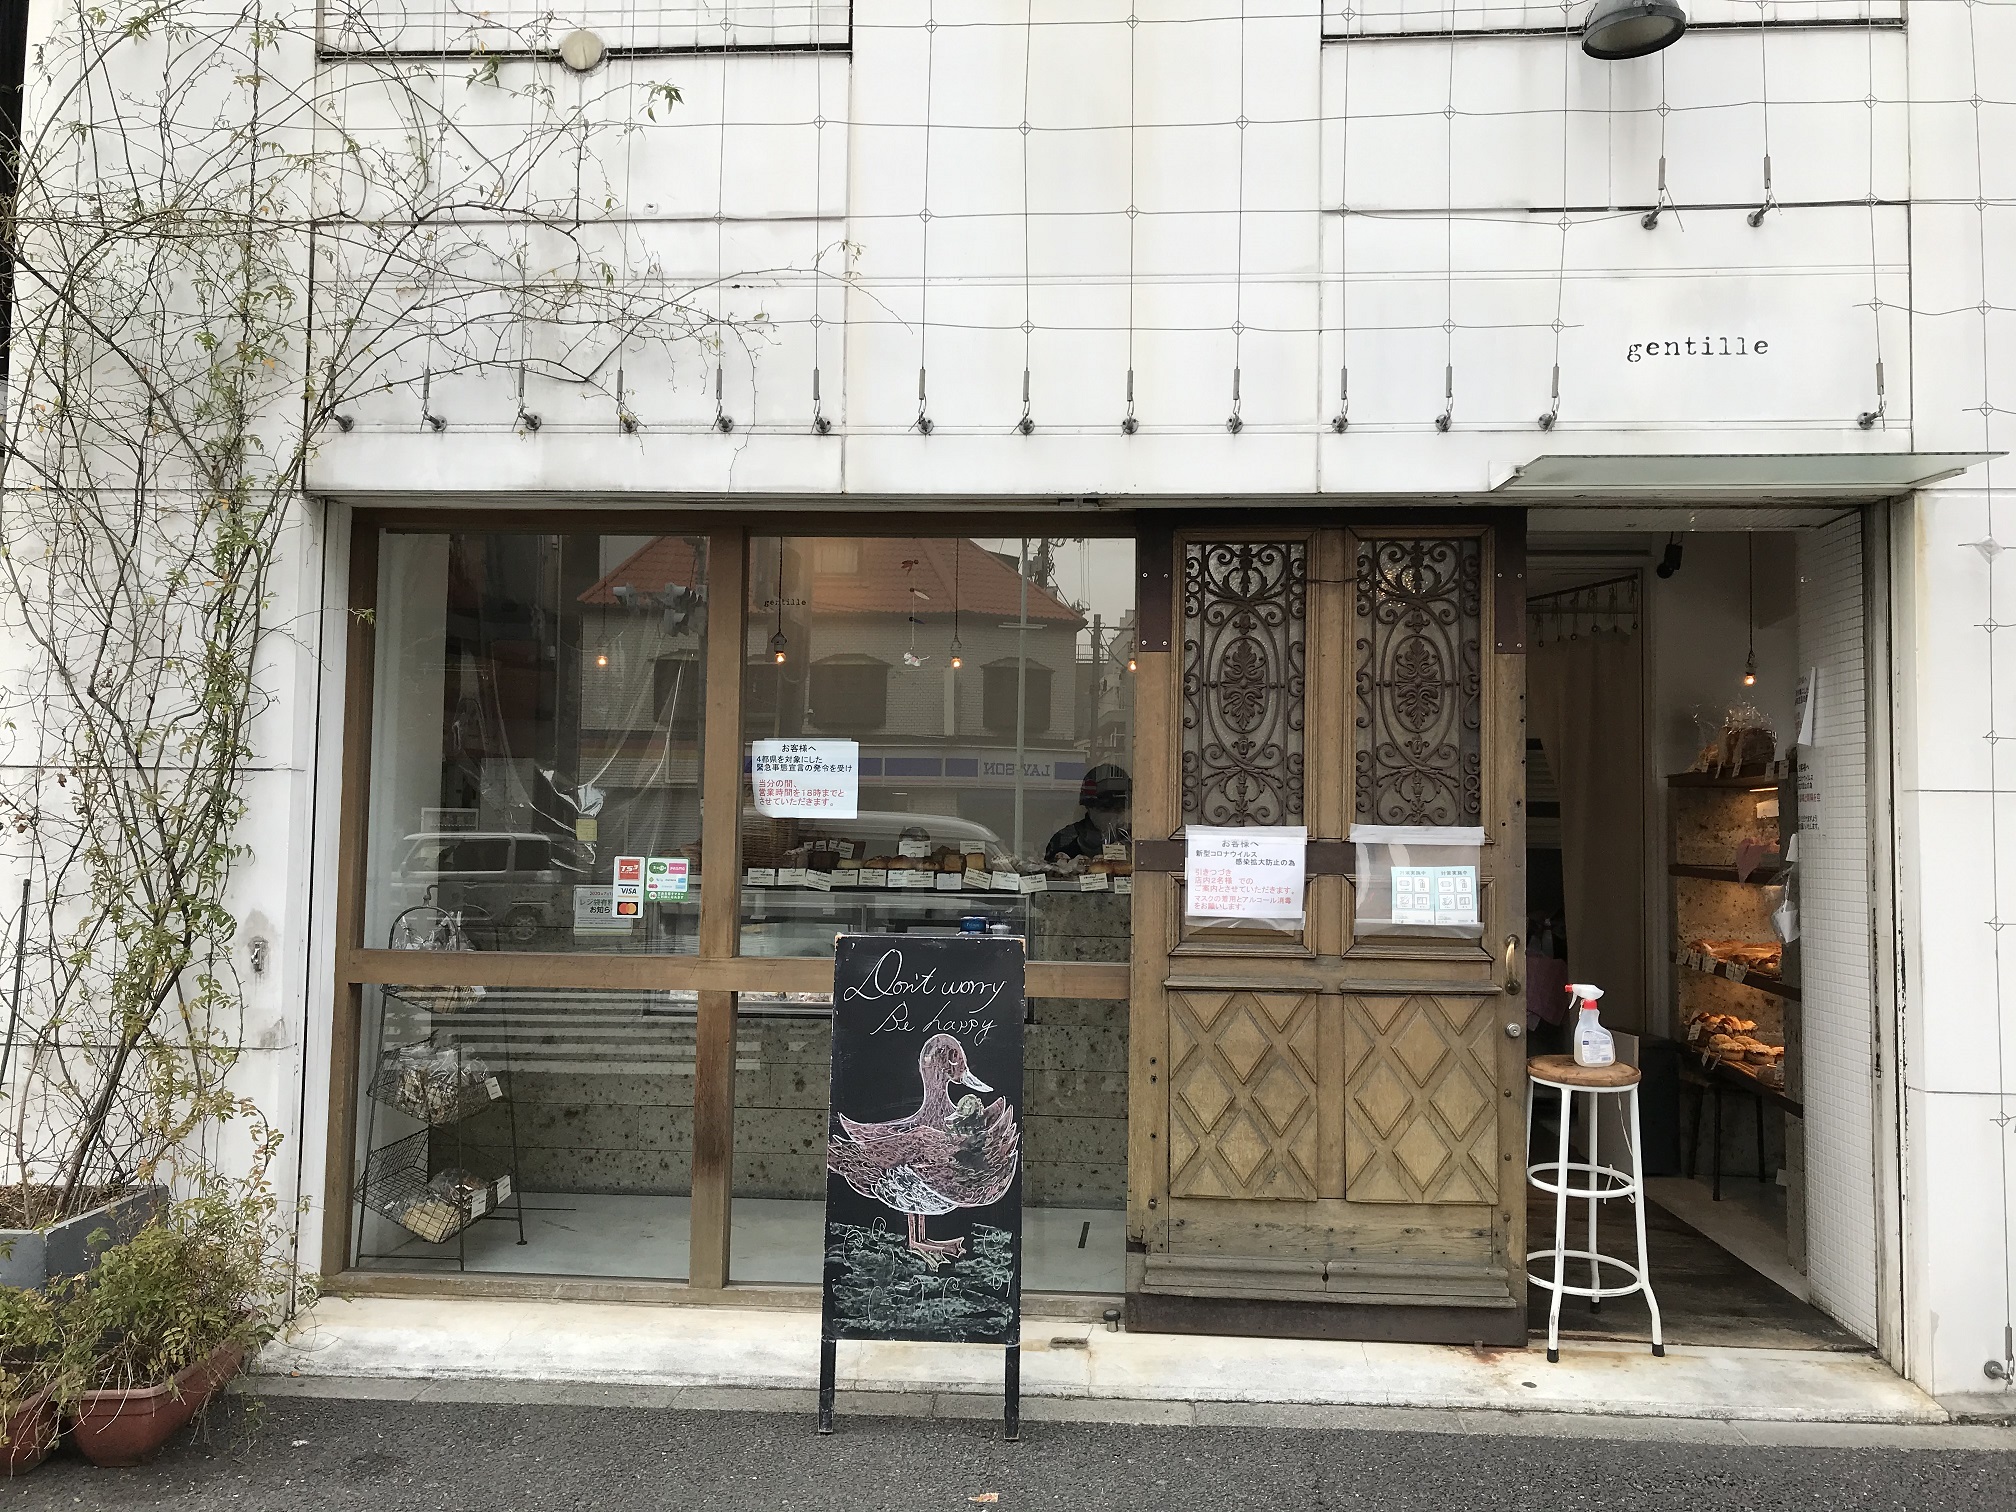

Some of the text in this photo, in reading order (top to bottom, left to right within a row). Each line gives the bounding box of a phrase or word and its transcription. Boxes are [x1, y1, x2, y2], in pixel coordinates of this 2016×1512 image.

[1626, 336, 1769, 363] gentille
[763, 598, 807, 608] gentille
[781, 743, 817, 753] お客様へ
[756, 755, 823, 764] 4都県を対象にした
[756, 763, 853, 773] 緊急事態宣言の発令を受け
[758, 779, 797, 788] 当分の間、
[758, 788, 845, 798] 営業時間を18時までと
[759, 797, 834, 807] させていただきます。
[1221, 839, 1260, 849] お客様へ
[1195, 849, 1258, 858] 新型コロナウイルス
[1235, 858, 1296, 867] 感染拡大防止の為
[1195, 868, 1233, 877] 引きつづき
[620, 887, 637, 895] VISA
[1194, 885, 1295, 895] ご案内とさせていただきます。
[843, 948, 1008, 1014] Don't worry
[869, 1000, 998, 1047] Be happy
